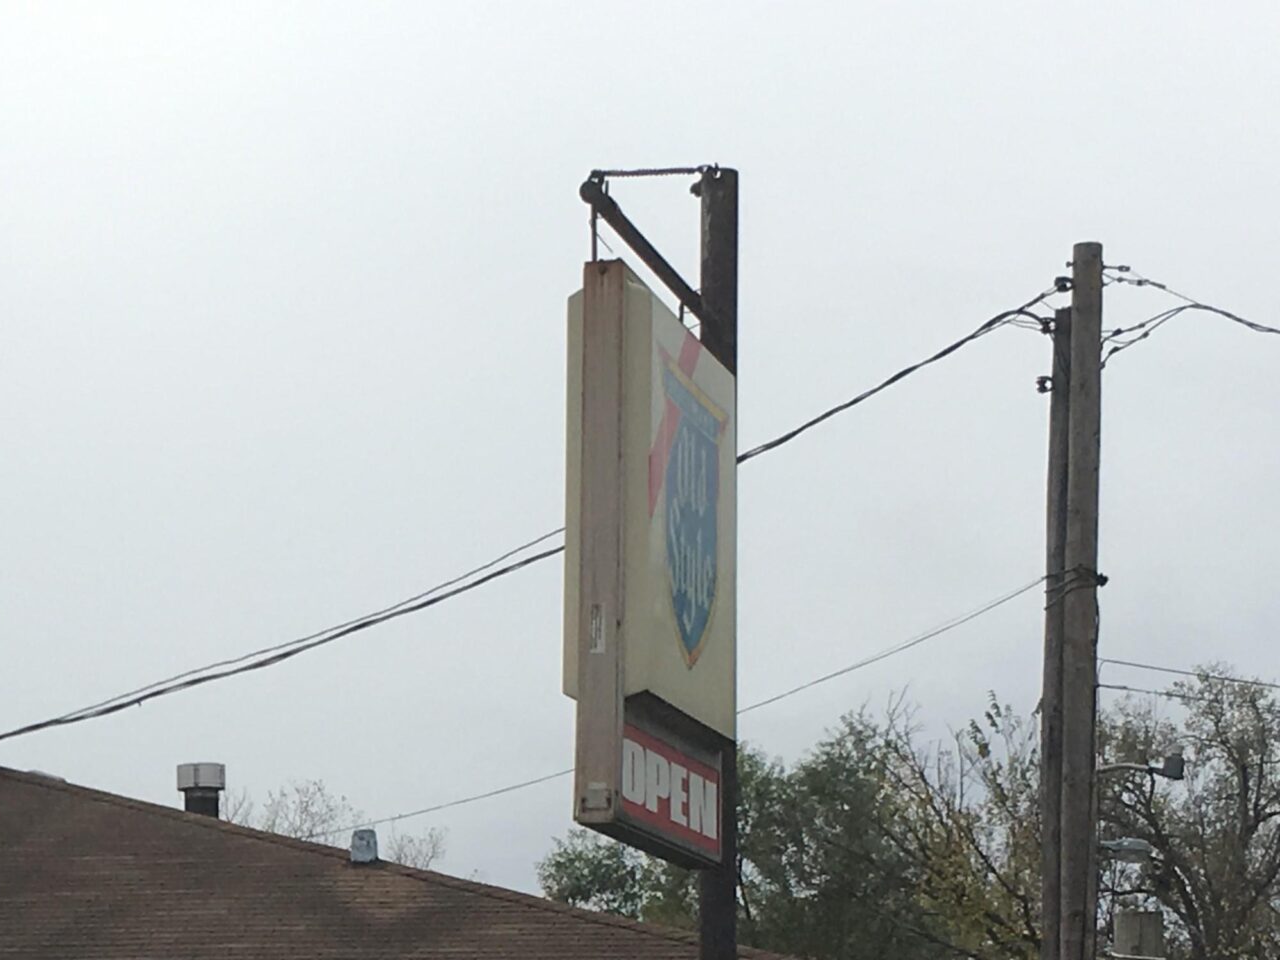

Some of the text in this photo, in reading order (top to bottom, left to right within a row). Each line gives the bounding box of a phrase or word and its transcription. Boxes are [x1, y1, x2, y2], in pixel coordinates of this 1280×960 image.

[676, 427, 708, 518] Old
[669, 498, 714, 636] Style
[621, 738, 718, 840] OPEN
